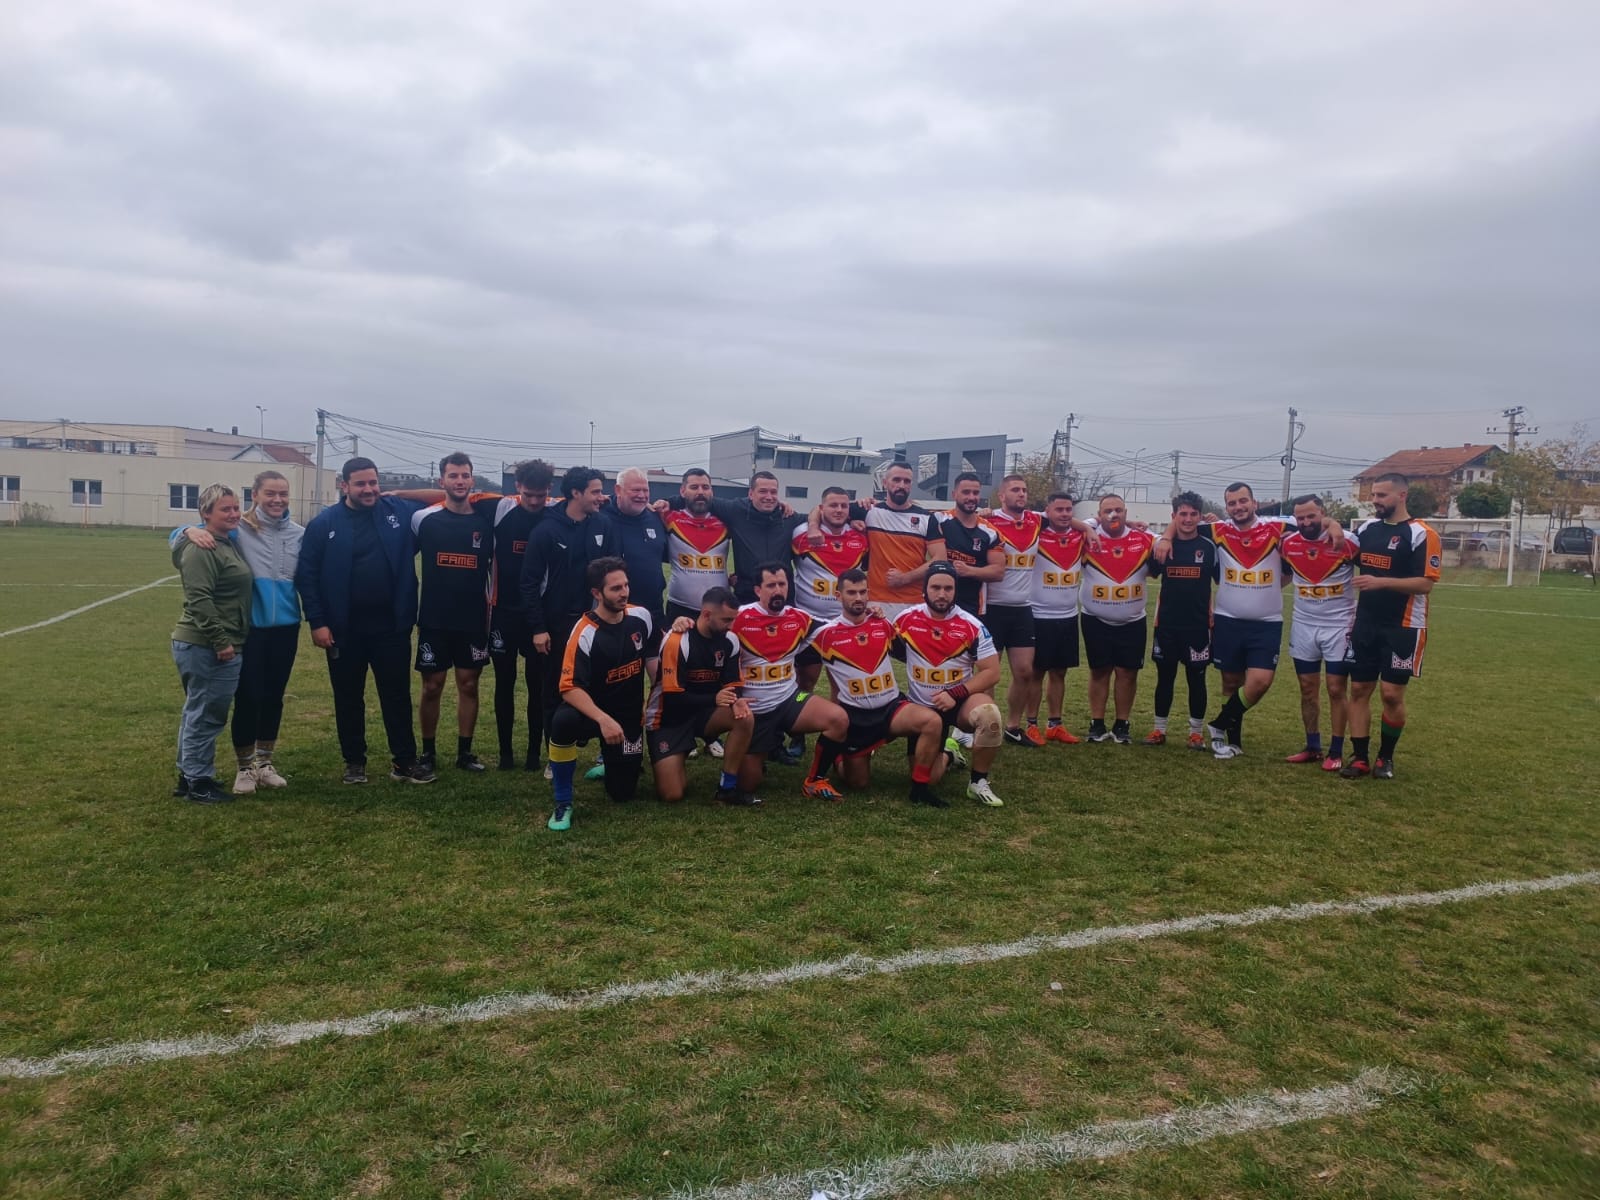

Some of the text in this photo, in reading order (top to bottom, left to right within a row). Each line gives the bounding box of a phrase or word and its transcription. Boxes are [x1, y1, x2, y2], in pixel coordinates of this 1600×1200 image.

[438, 553, 477, 567] FAME
[681, 555, 724, 568] SCP
[1361, 554, 1389, 568] FAME
[1167, 568, 1200, 577] FAME
[1226, 569, 1271, 583] SCP
[1096, 585, 1142, 598] SCP
[608, 659, 641, 682] FAME
[749, 663, 792, 680] SCP
[914, 667, 960, 683] SCP
[851, 674, 891, 693] SCP
